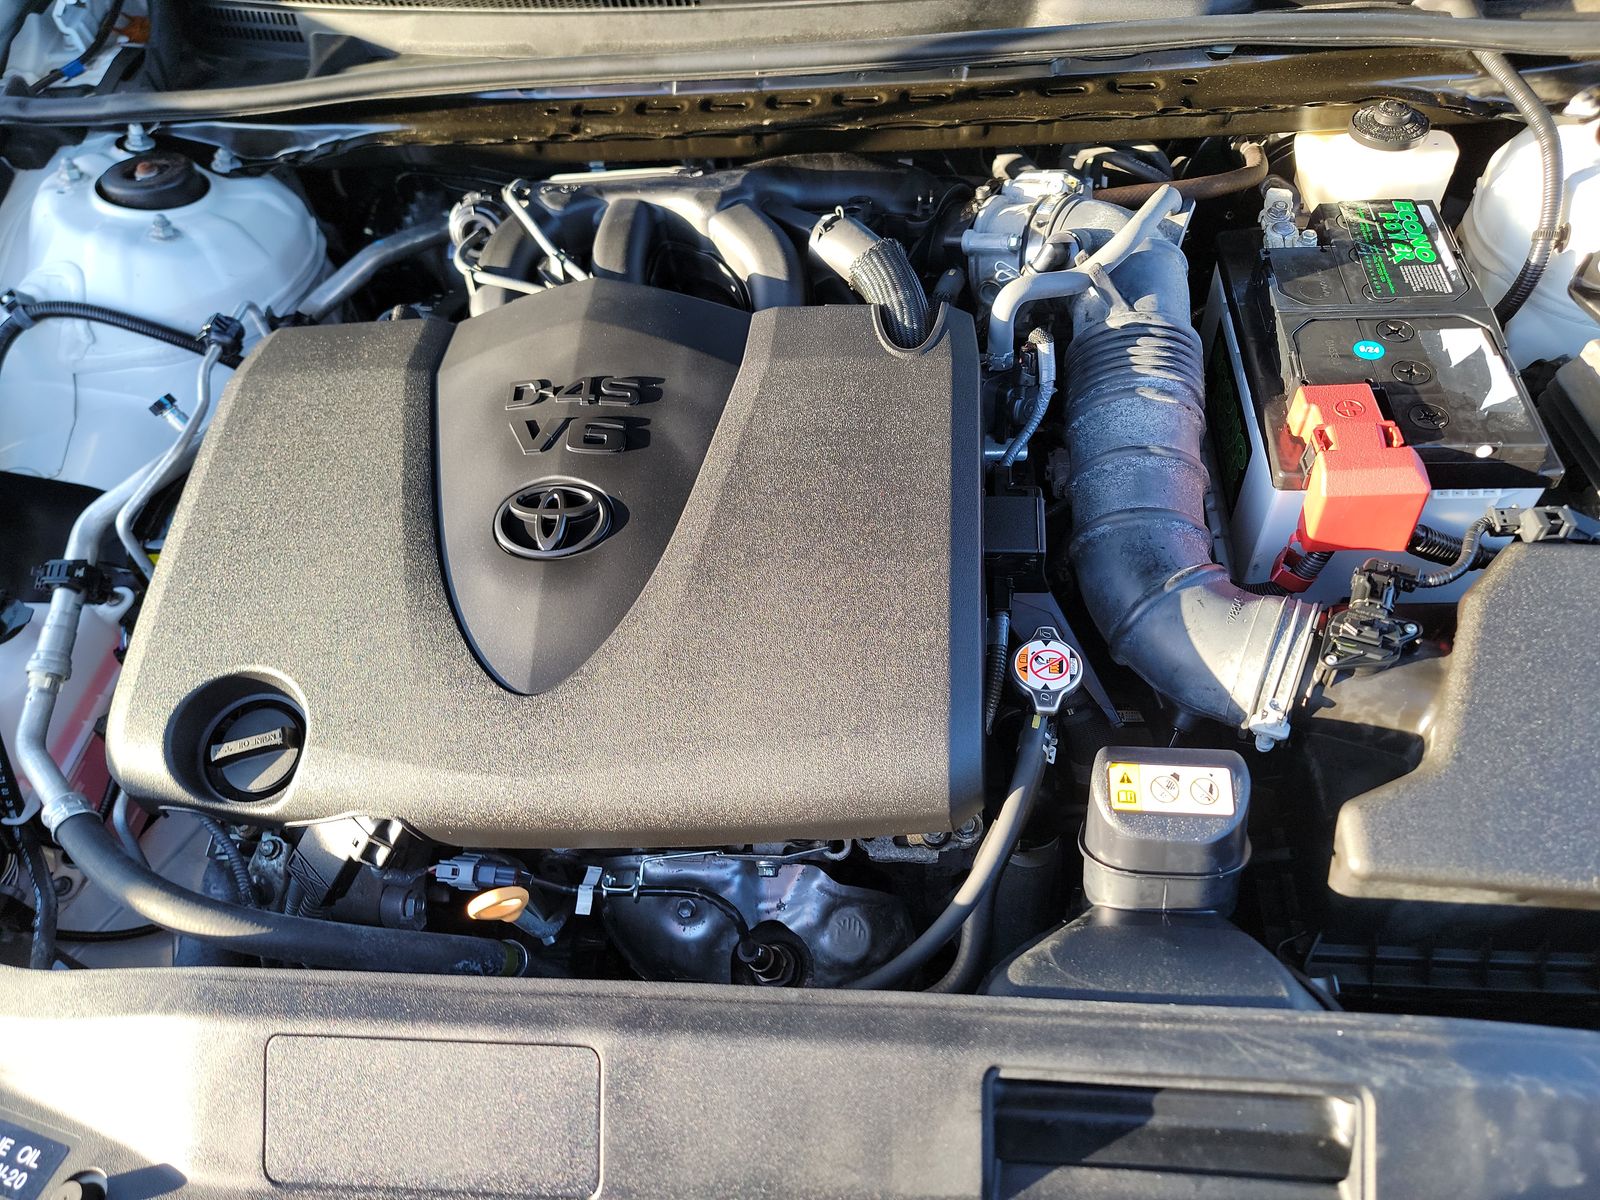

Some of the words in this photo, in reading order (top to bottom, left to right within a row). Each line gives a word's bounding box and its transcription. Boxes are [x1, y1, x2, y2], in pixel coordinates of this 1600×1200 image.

[1378, 212, 1416, 264] POWER
[1392, 200, 1437, 263] ECONO
[504, 376, 641, 411] D-4S
[508, 416, 628, 456] V6
[17, 1145, 41, 1169] OIL
